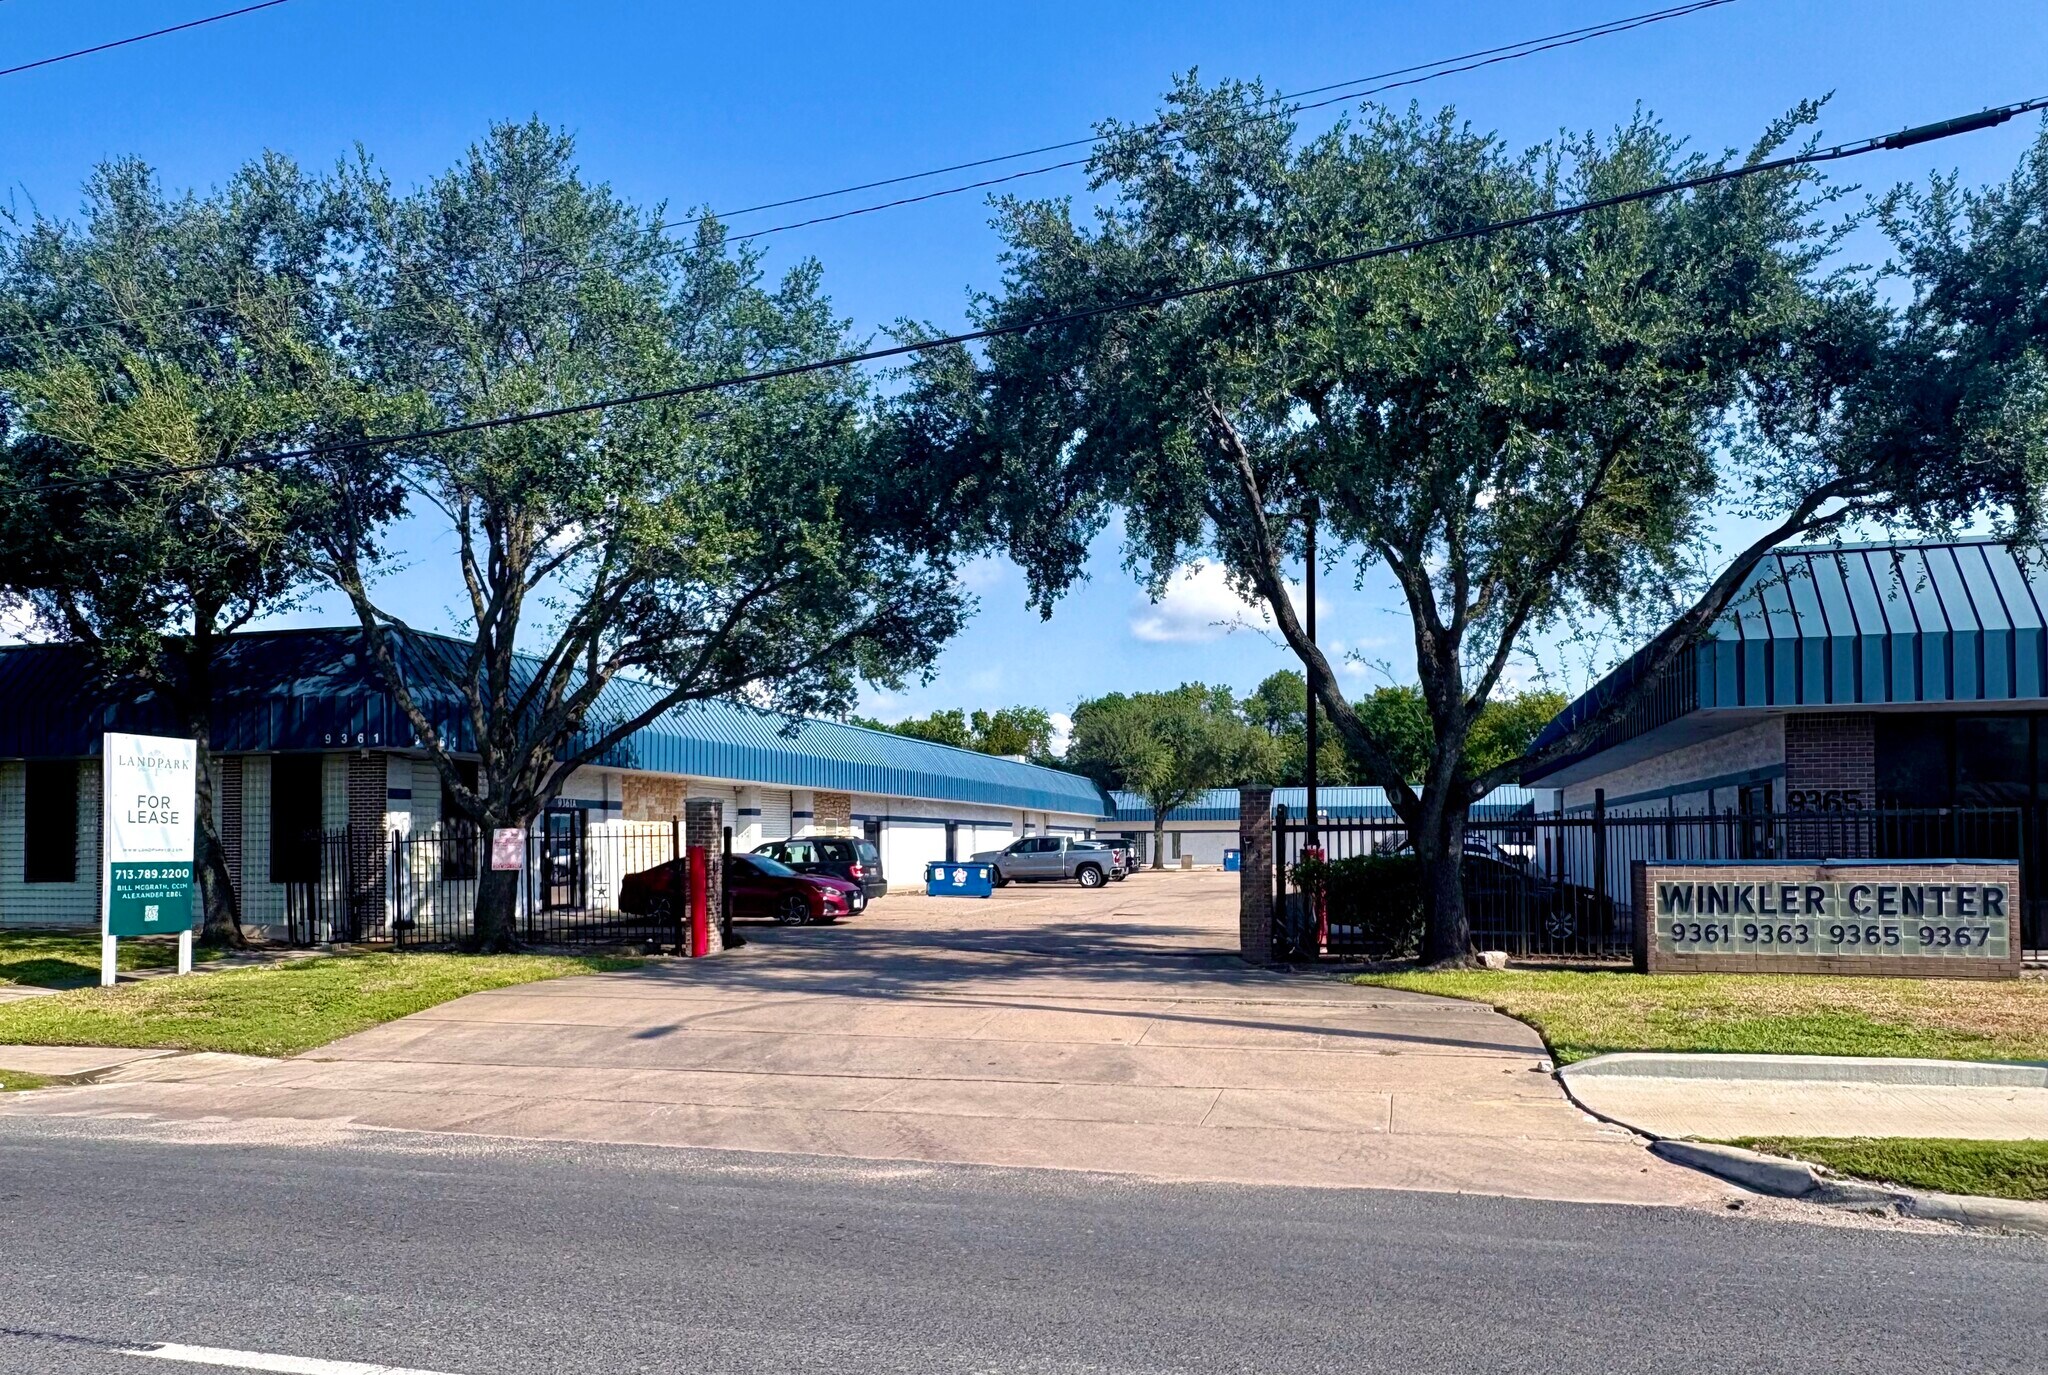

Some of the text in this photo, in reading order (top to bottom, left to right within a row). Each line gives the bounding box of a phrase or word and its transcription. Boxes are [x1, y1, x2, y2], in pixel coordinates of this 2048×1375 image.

[324, 733, 379, 744] 9361
[413, 734, 457, 747] 961
[119, 755, 190, 770] LANDPARK
[137, 795, 171, 809] FOR
[1788, 789, 1862, 813] 9365
[128, 810, 180, 825] LEASE
[115, 868, 190, 880] 713.789.2200
[116, 884, 133, 892] BILL
[122, 891, 164, 899] ALEXANDER
[1660, 885, 2004, 916] WINKLER CENTER
[1671, 923, 1990, 947] 9361 9363 9365 9367
